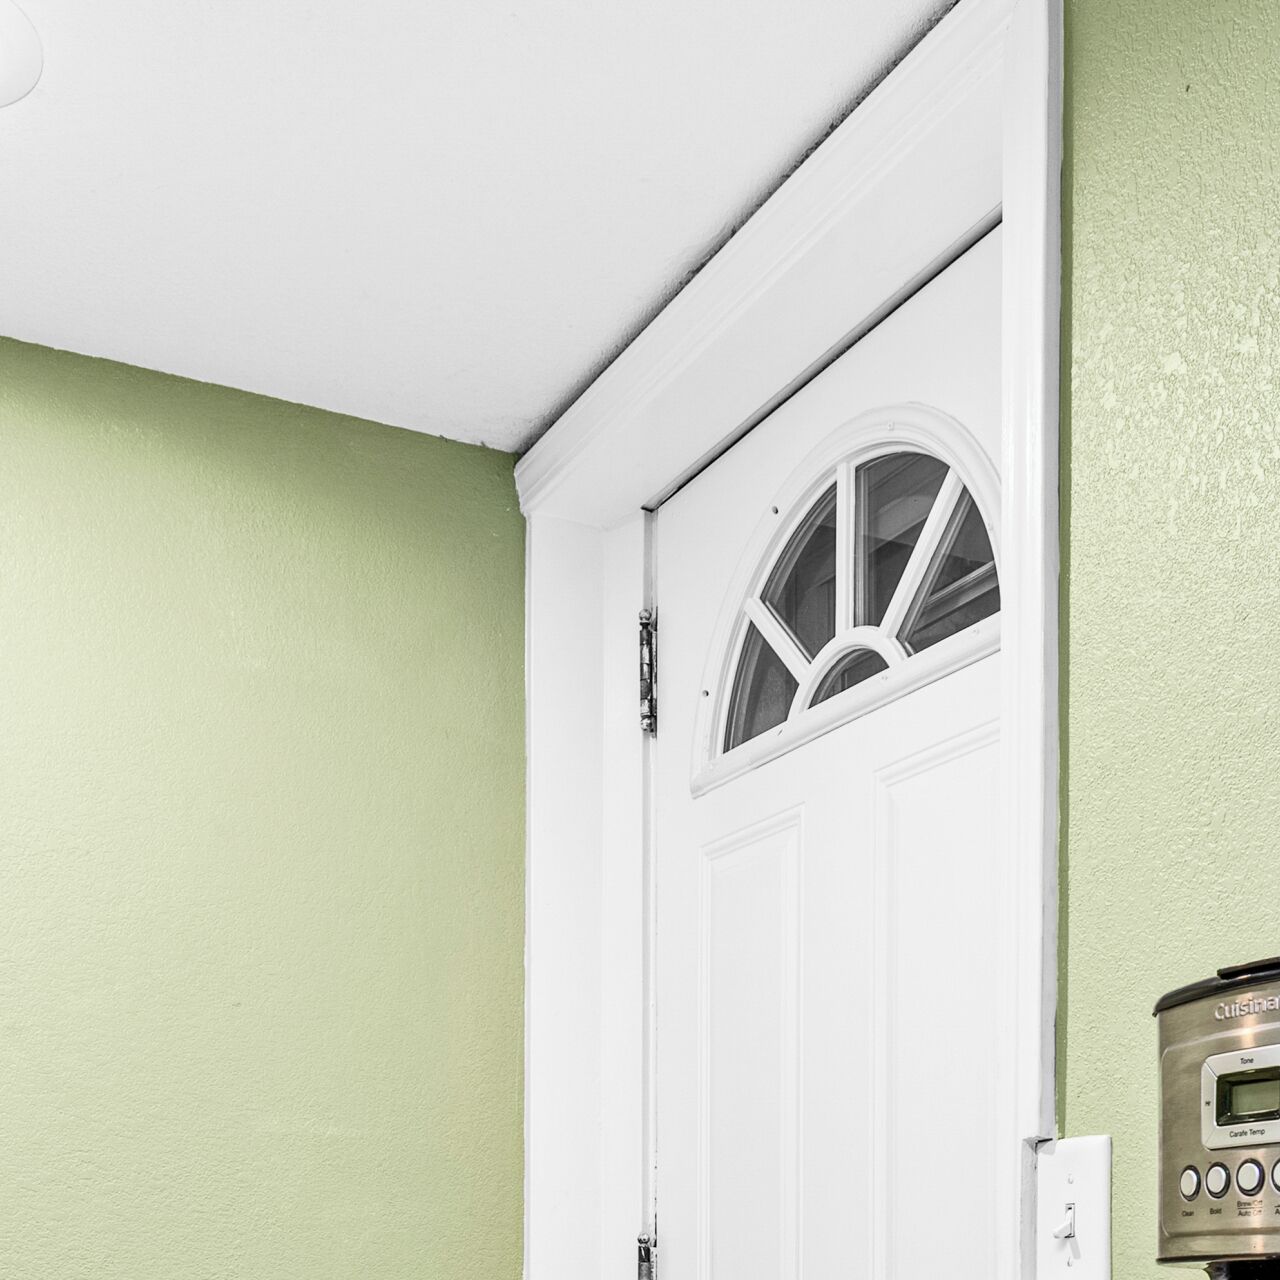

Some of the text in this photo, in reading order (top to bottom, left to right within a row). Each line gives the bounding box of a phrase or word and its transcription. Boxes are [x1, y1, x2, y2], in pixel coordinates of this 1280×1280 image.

[1240, 1057, 1254, 1065] Tone
[1229, 1128, 1266, 1138] Carafe Temp
